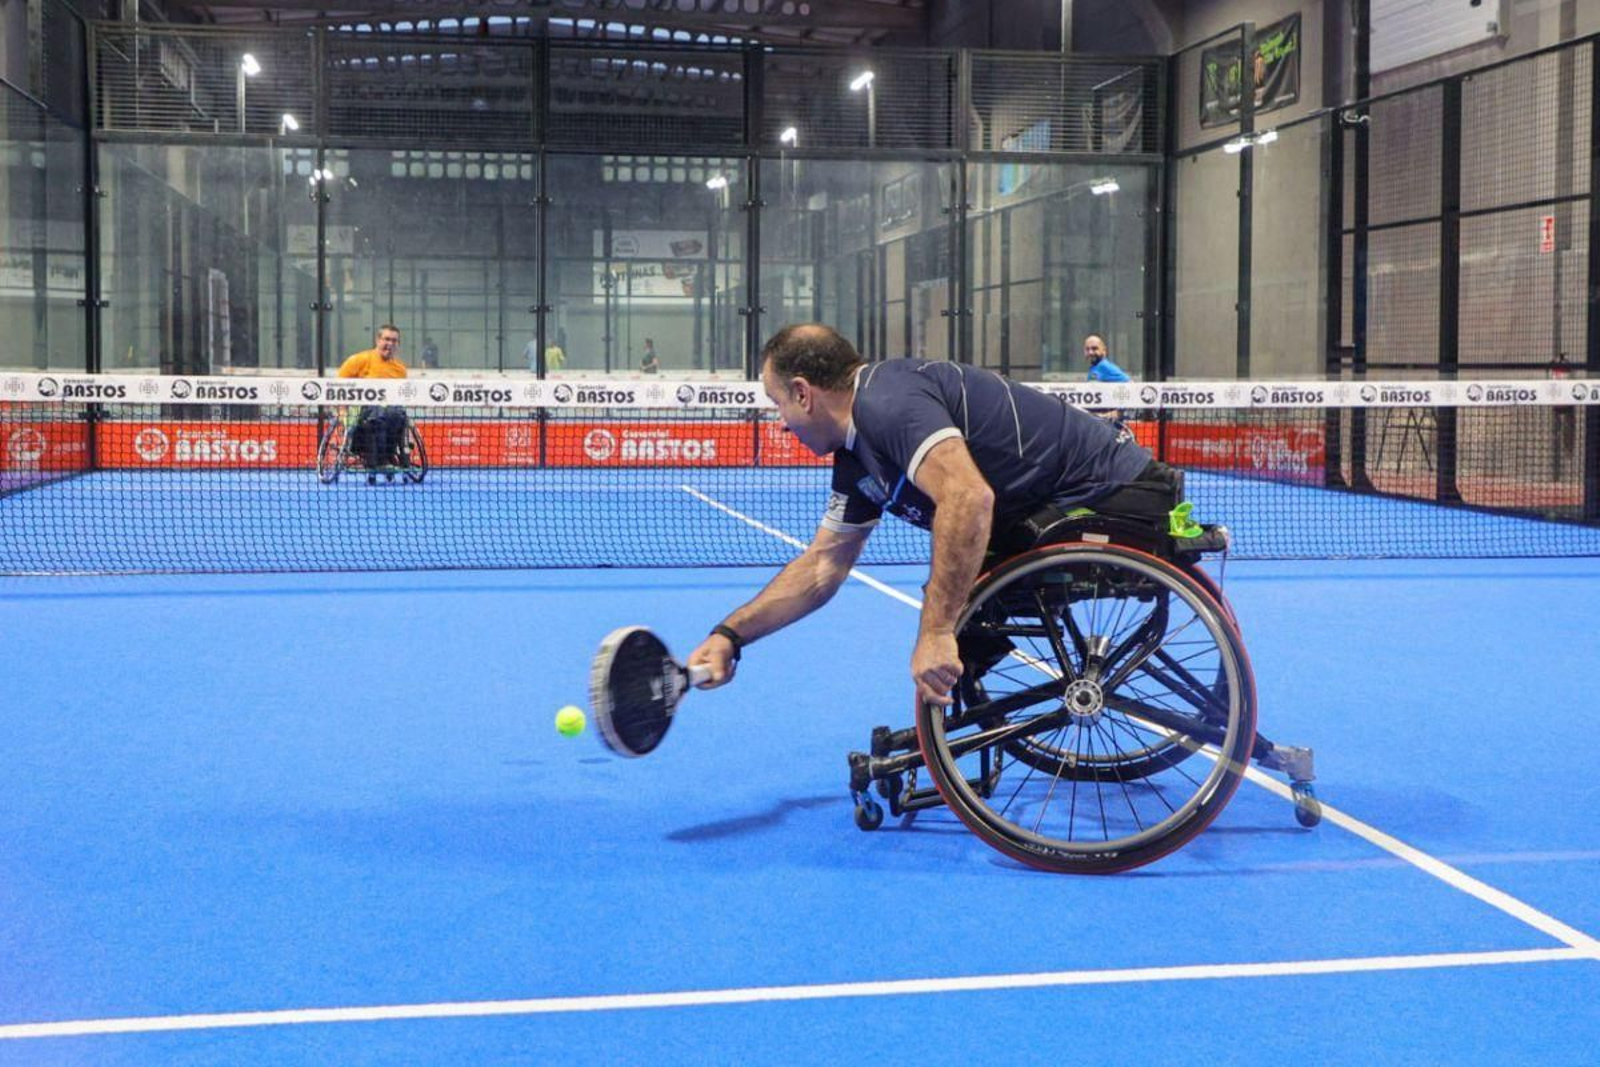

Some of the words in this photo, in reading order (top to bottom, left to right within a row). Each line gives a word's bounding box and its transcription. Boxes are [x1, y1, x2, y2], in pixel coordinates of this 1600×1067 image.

[63, 384, 127, 398] BASTOS
[196, 386, 258, 400] BASTOS
[325, 387, 386, 401] BASTOS
[452, 389, 512, 402] BASTOS
[577, 390, 635, 404] BASTOS
[698, 391, 756, 404] BASTOS
[1271, 391, 1324, 403] BASTOS
[1380, 391, 1431, 403] BASTOS
[1486, 389, 1537, 401] BASTOS
[1051, 392, 1103, 404] ASTOS
[1161, 392, 1215, 404] BASTOS
[175, 439, 277, 461] BASTOS
[621, 439, 716, 461] BASTOS
